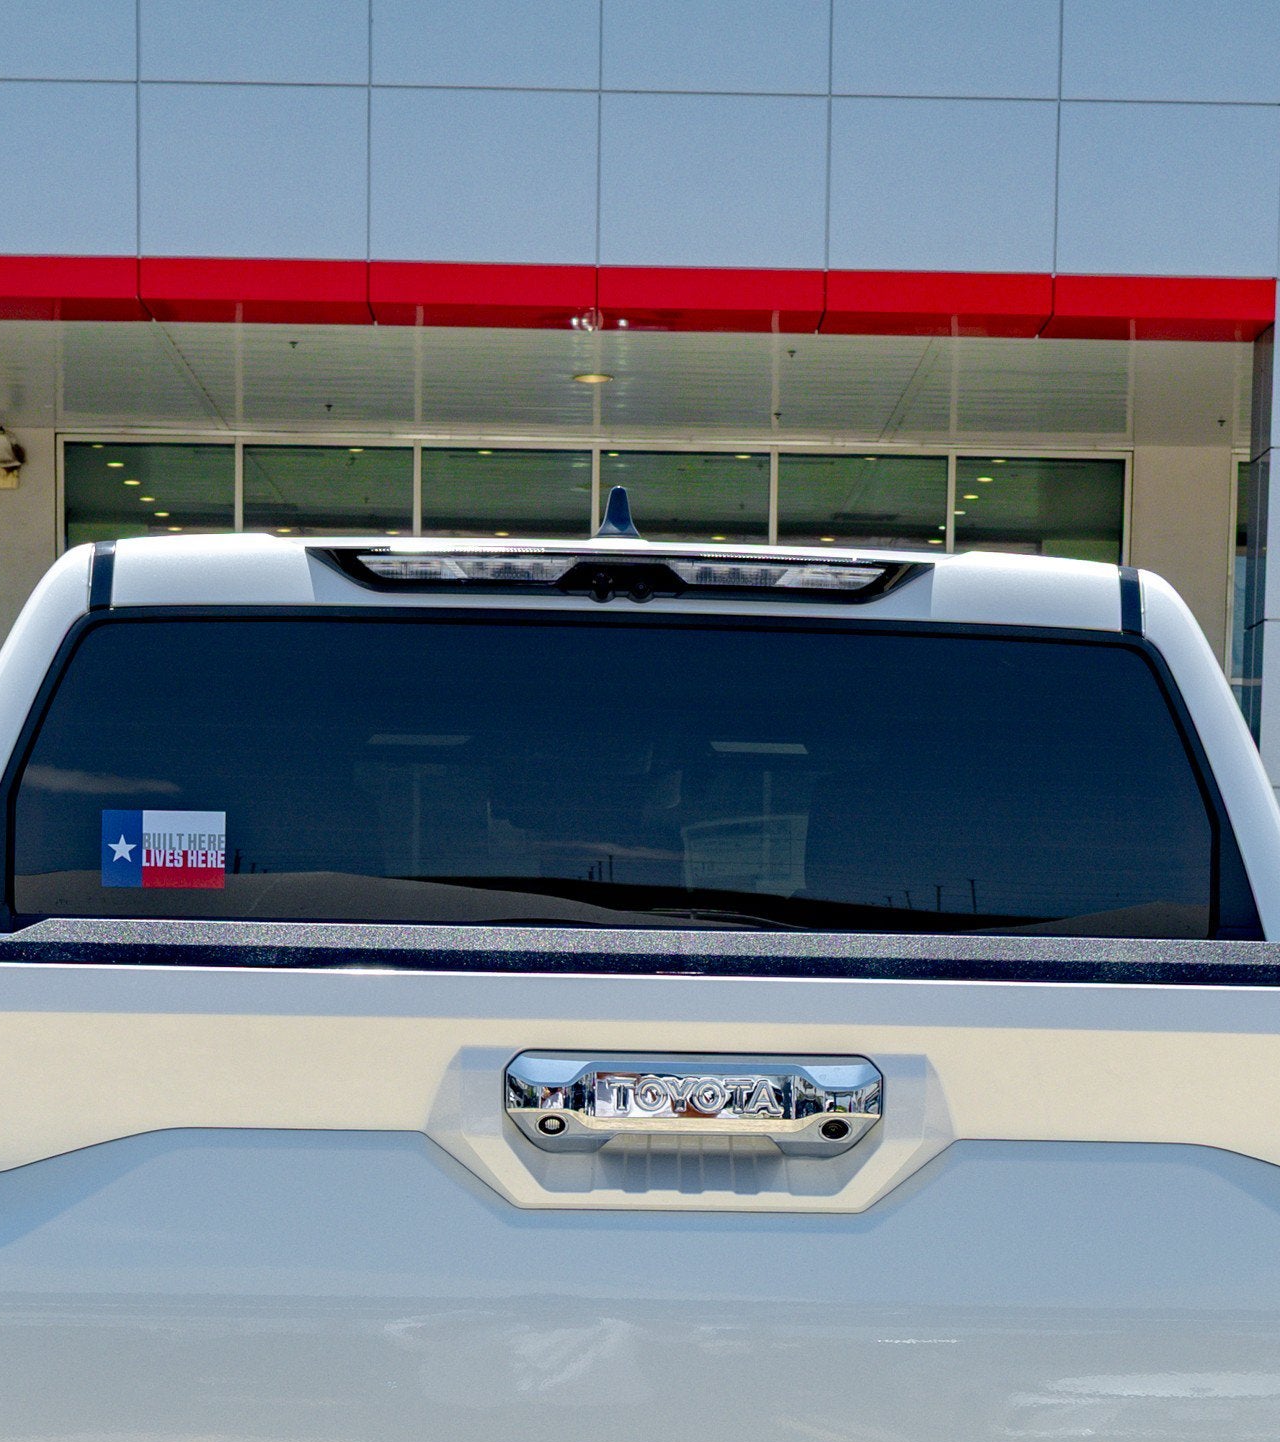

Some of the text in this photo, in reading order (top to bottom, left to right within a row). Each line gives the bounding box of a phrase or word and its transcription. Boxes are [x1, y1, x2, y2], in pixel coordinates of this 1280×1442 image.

[143, 832, 225, 851] BUILT HERE
[142, 849, 225, 868] LIVES HERE
[606, 1075, 784, 1116] TOYOTA
